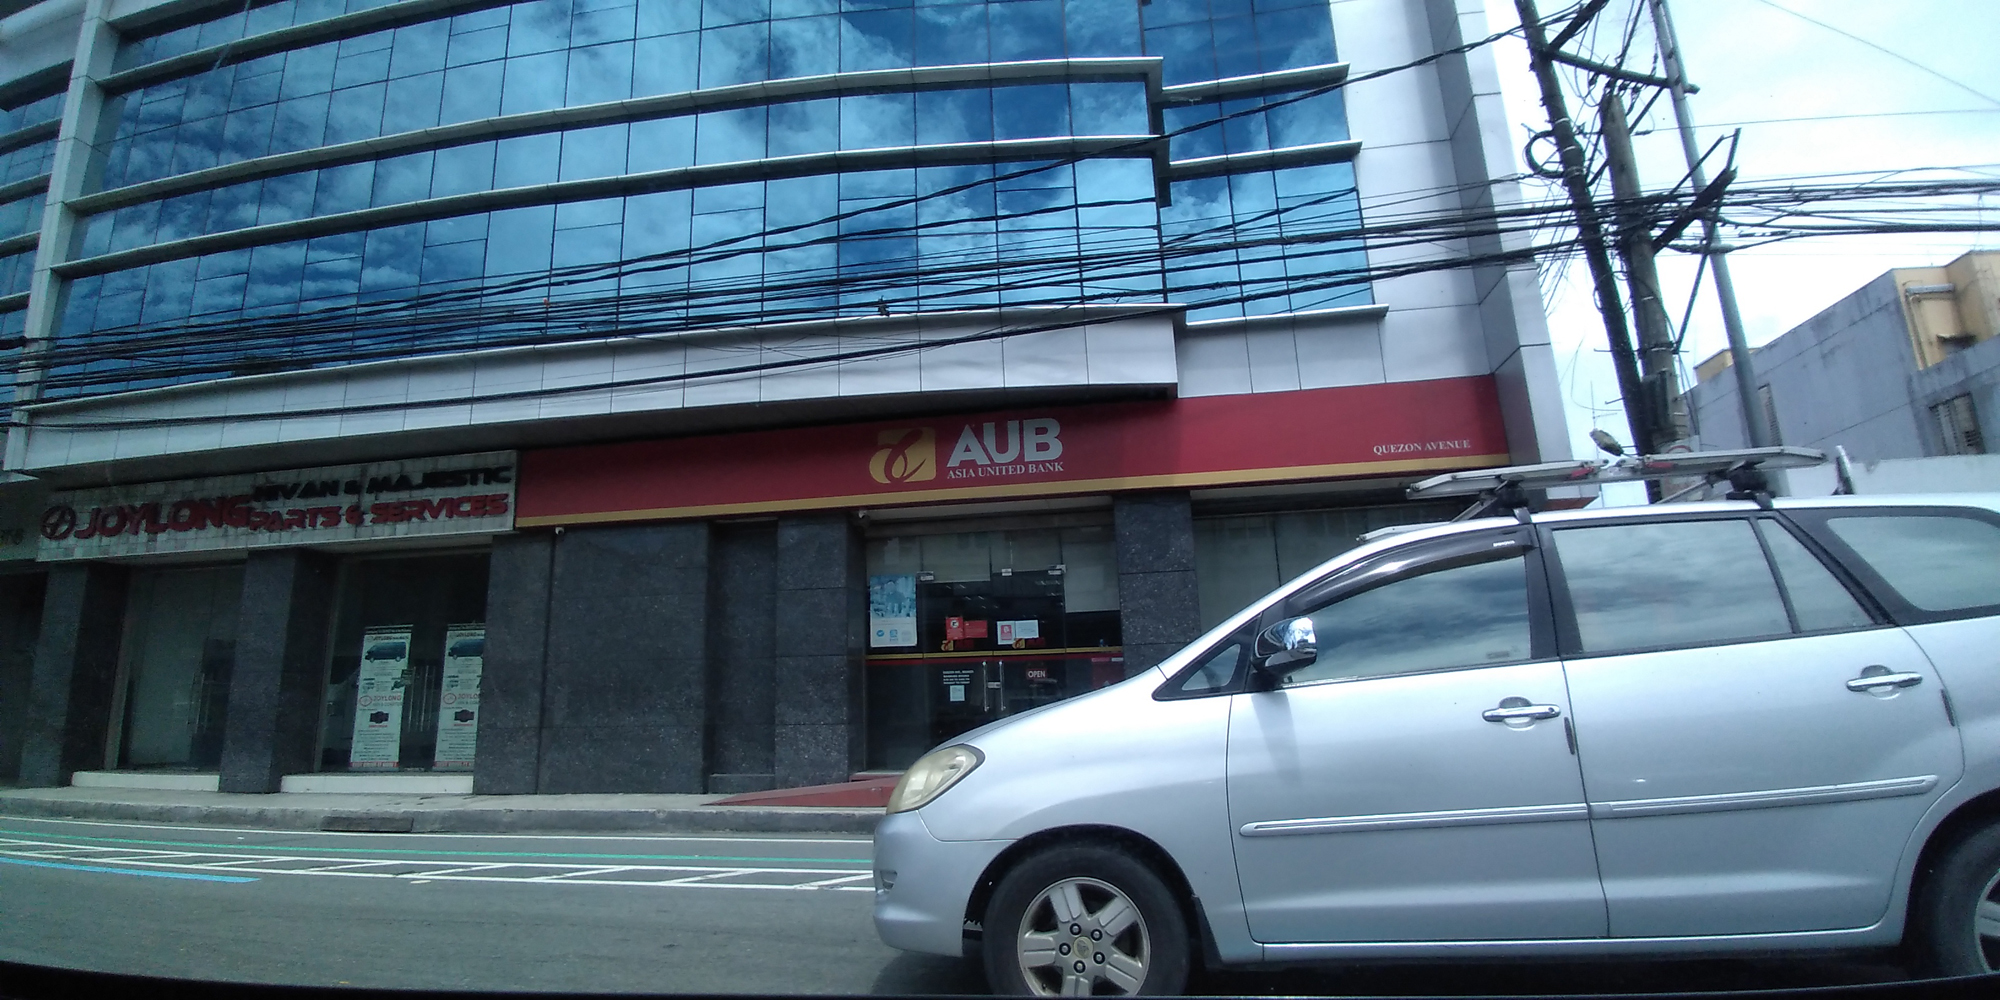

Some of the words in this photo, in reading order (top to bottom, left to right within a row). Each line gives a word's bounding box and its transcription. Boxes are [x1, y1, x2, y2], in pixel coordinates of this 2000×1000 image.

[946, 417, 1063, 467] AUB
[1373, 443, 1422, 455] QUEZON
[1425, 440, 1471, 451] AVENUE
[366, 465, 513, 494] MAJESTIC
[947, 468, 976, 479] ASIA
[978, 465, 1025, 477] UNITED
[1028, 462, 1064, 474] BANK
[74, 494, 253, 540] JOYLONG
[249, 505, 342, 532] PARTS
[369, 493, 509, 524] SERVICES
[1028, 670, 1046, 678] OPEN
